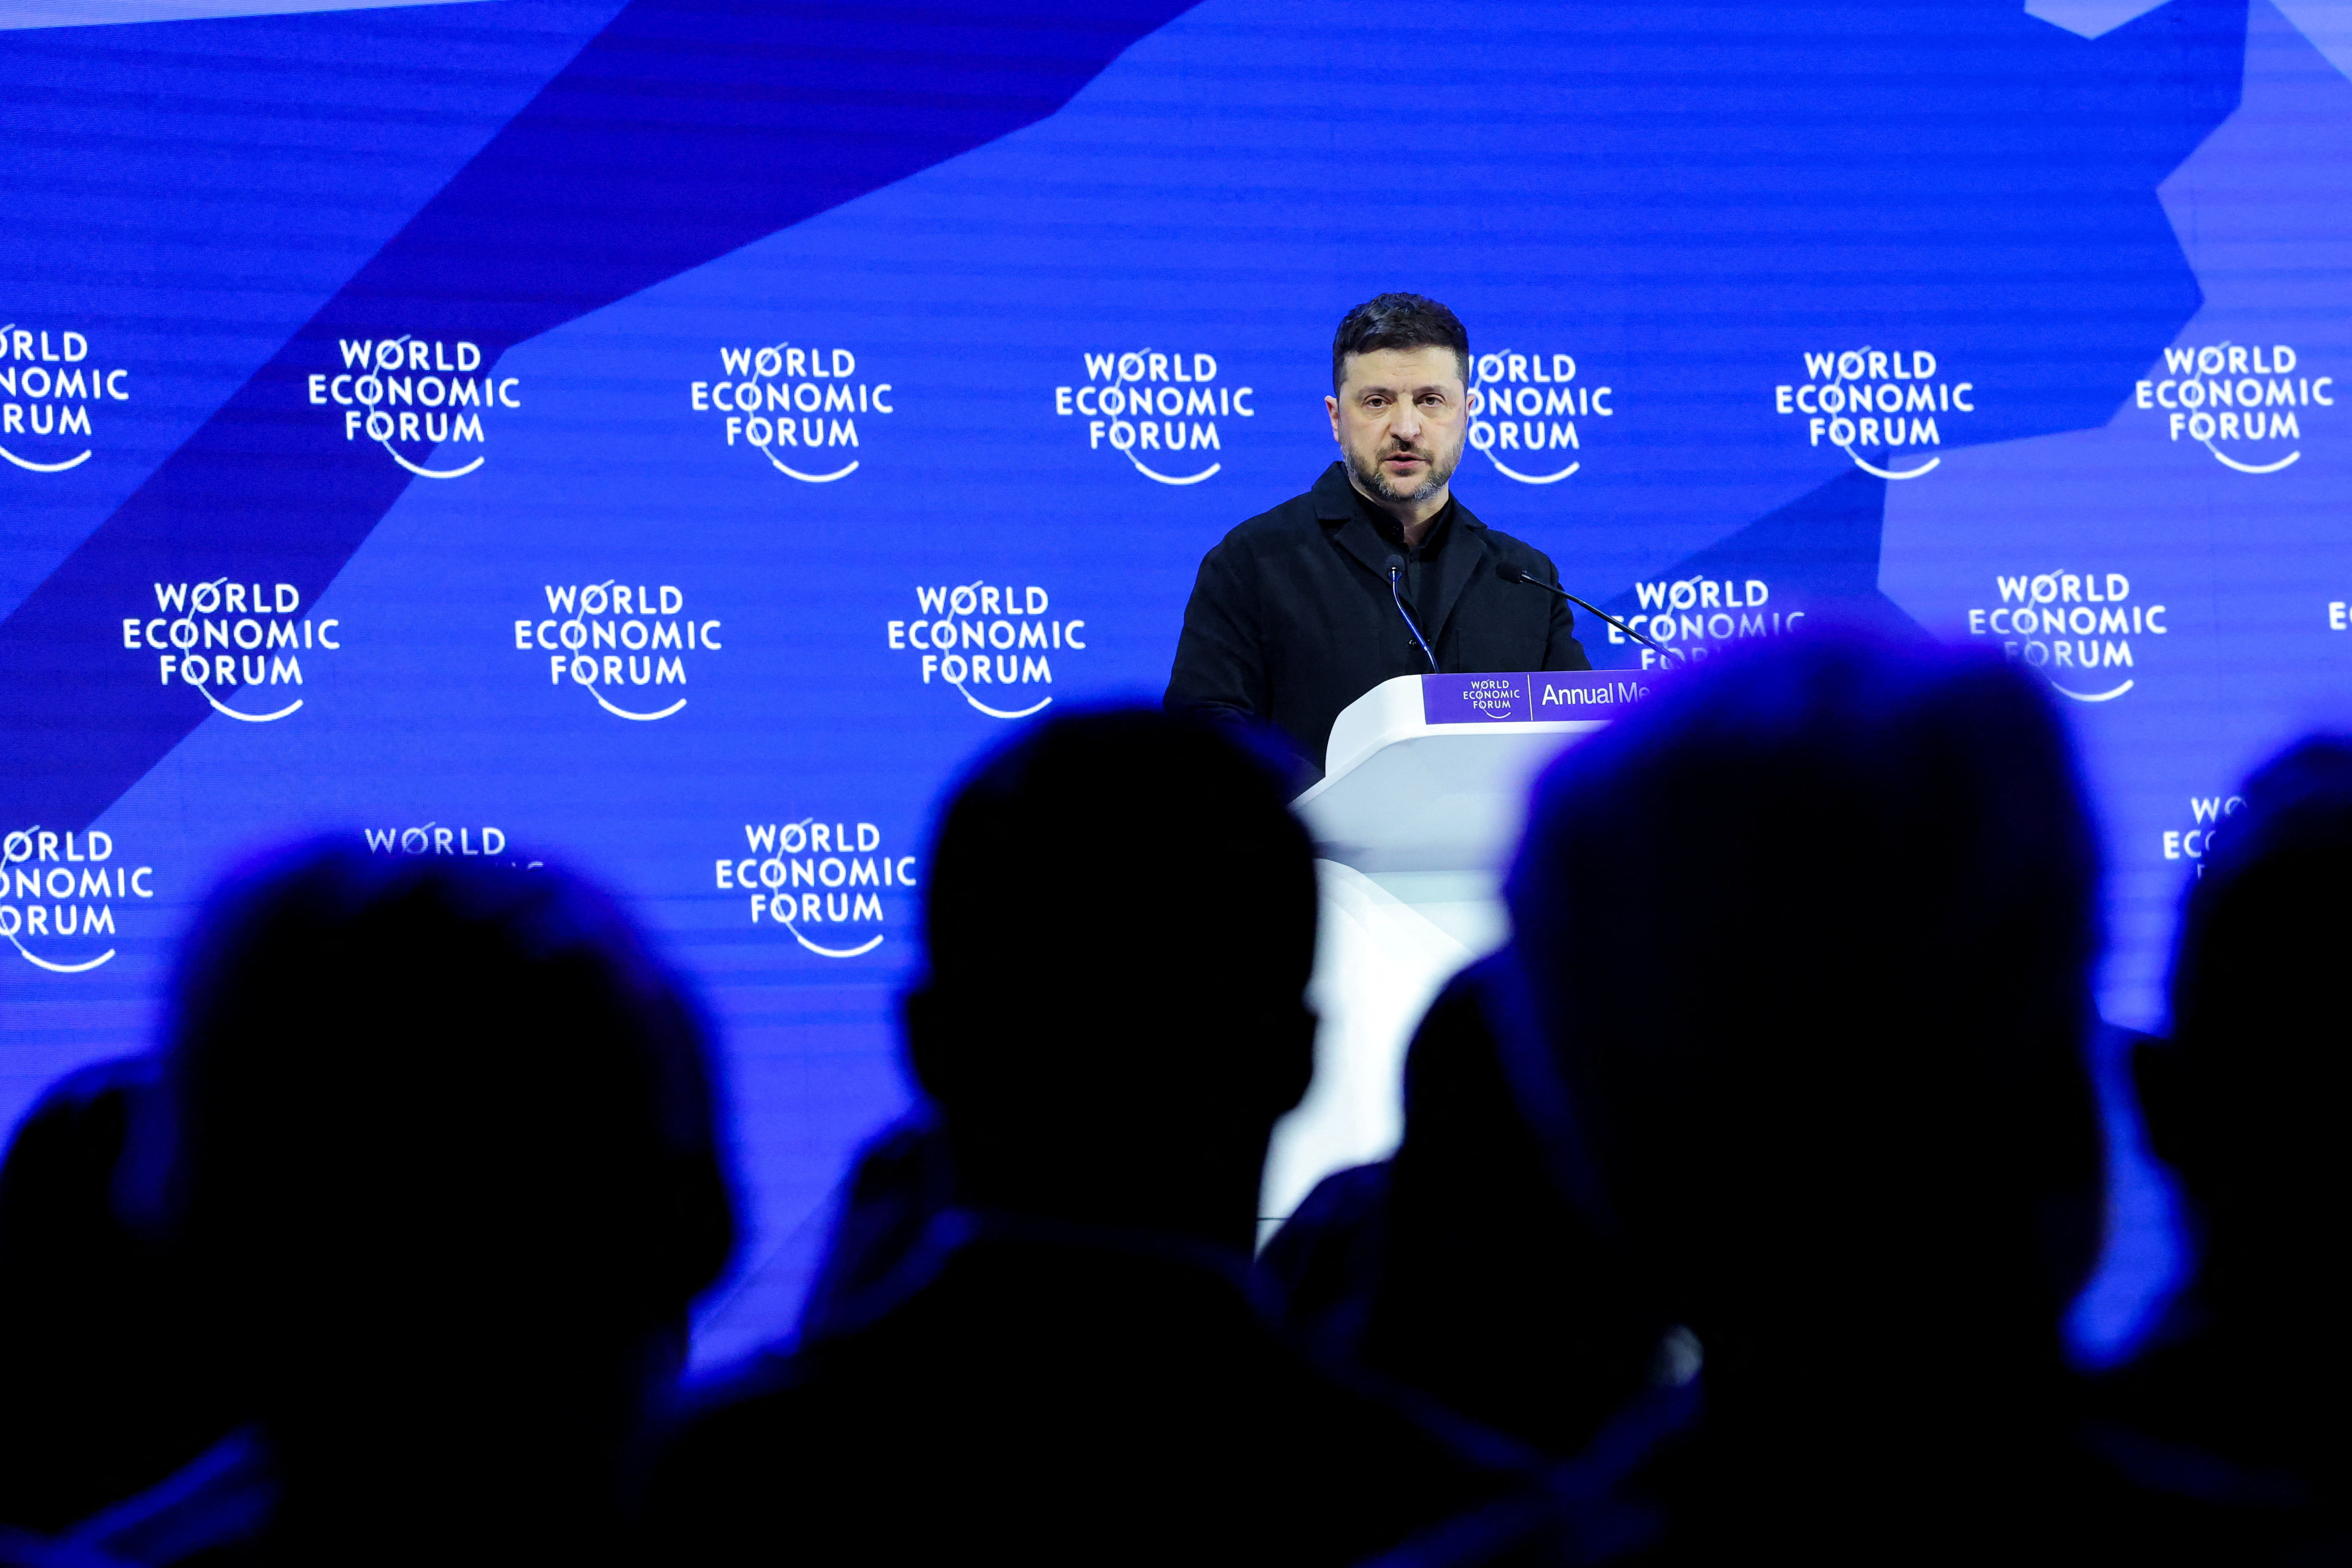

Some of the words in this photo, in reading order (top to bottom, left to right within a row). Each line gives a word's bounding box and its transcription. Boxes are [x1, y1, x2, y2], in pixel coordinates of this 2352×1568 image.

[0, 330, 88, 362] RLD
[339, 339, 481, 372] WORLD
[2164, 345, 2297, 375] WORLD
[720, 347, 855, 378] WORLD
[1084, 352, 1217, 382] WORLD
[1804, 351, 1936, 379] WORLD
[0, 366, 129, 400] NOMIC
[308, 374, 521, 408] ECONOMIC
[691, 381, 894, 413] ECONOMIC
[1776, 382, 1974, 414] ECONOMIC
[2136, 376, 2334, 409] ECONOMIC
[1055, 386, 1254, 416] ECONOMIC
[1467, 387, 1613, 416] ONOMIC
[3, 403, 92, 435] RUM
[346, 410, 485, 443] FORUM
[726, 416, 859, 447] FORUM
[1809, 417, 1941, 447] FORUM
[2169, 411, 2300, 442] FORUM
[1090, 420, 1221, 450] FORUM
[1468, 421, 1580, 450] ORUM
[154, 583, 299, 613] WORLD
[544, 585, 683, 615] WORLD
[916, 586, 1049, 615] WORLD
[1635, 580, 1769, 610] WORLD
[1996, 573, 2130, 603] WORLD
[122, 618, 340, 650] ECONOMIC
[514, 619, 722, 650] ECONOMIC
[887, 619, 1086, 650] ECONOMIC
[1968, 605, 2168, 635] ECONOMIC
[2004, 640, 2134, 668] FORUM
[160, 655, 304, 686] FORUM
[550, 655, 687, 685] FORUM
[922, 655, 1053, 684] FORUM
[1471, 680, 1509, 689] WORLD
[1463, 689, 1520, 700] ECONOMIC
[1473, 700, 1511, 709] FORUM
[1541, 682, 1614, 706] Annual
[3, 831, 112, 862] ORLD
[364, 827, 505, 855] WORLD
[745, 822, 881, 853] WORLD
[0, 867, 154, 899] NOMIC
[715, 856, 916, 889] ECONOMIC
[0, 904, 115, 935] ORUM
[751, 892, 884, 924] FORUM
